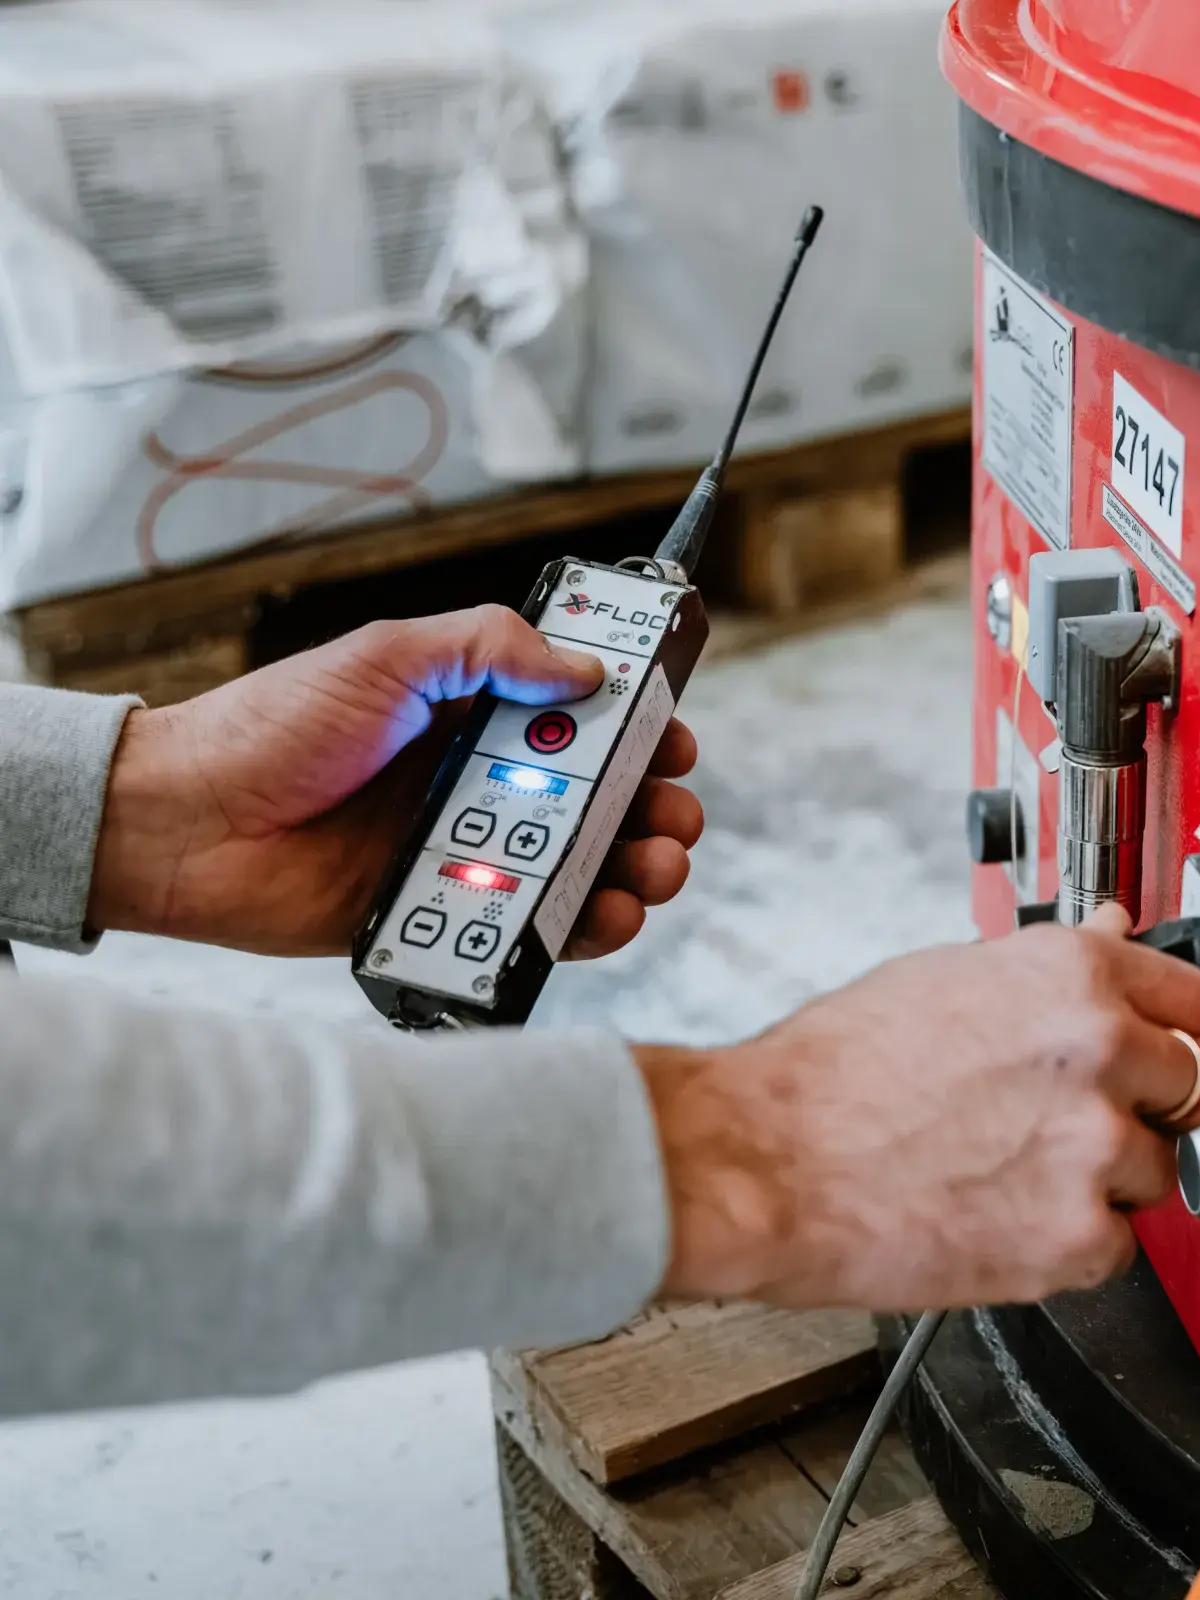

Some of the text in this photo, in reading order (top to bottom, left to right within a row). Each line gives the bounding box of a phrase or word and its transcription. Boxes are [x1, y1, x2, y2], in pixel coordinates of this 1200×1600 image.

[1053, 340, 1064, 377] CE
[1114, 405, 1179, 517] 27147
[554, 592, 667, 630] X-FLOC
